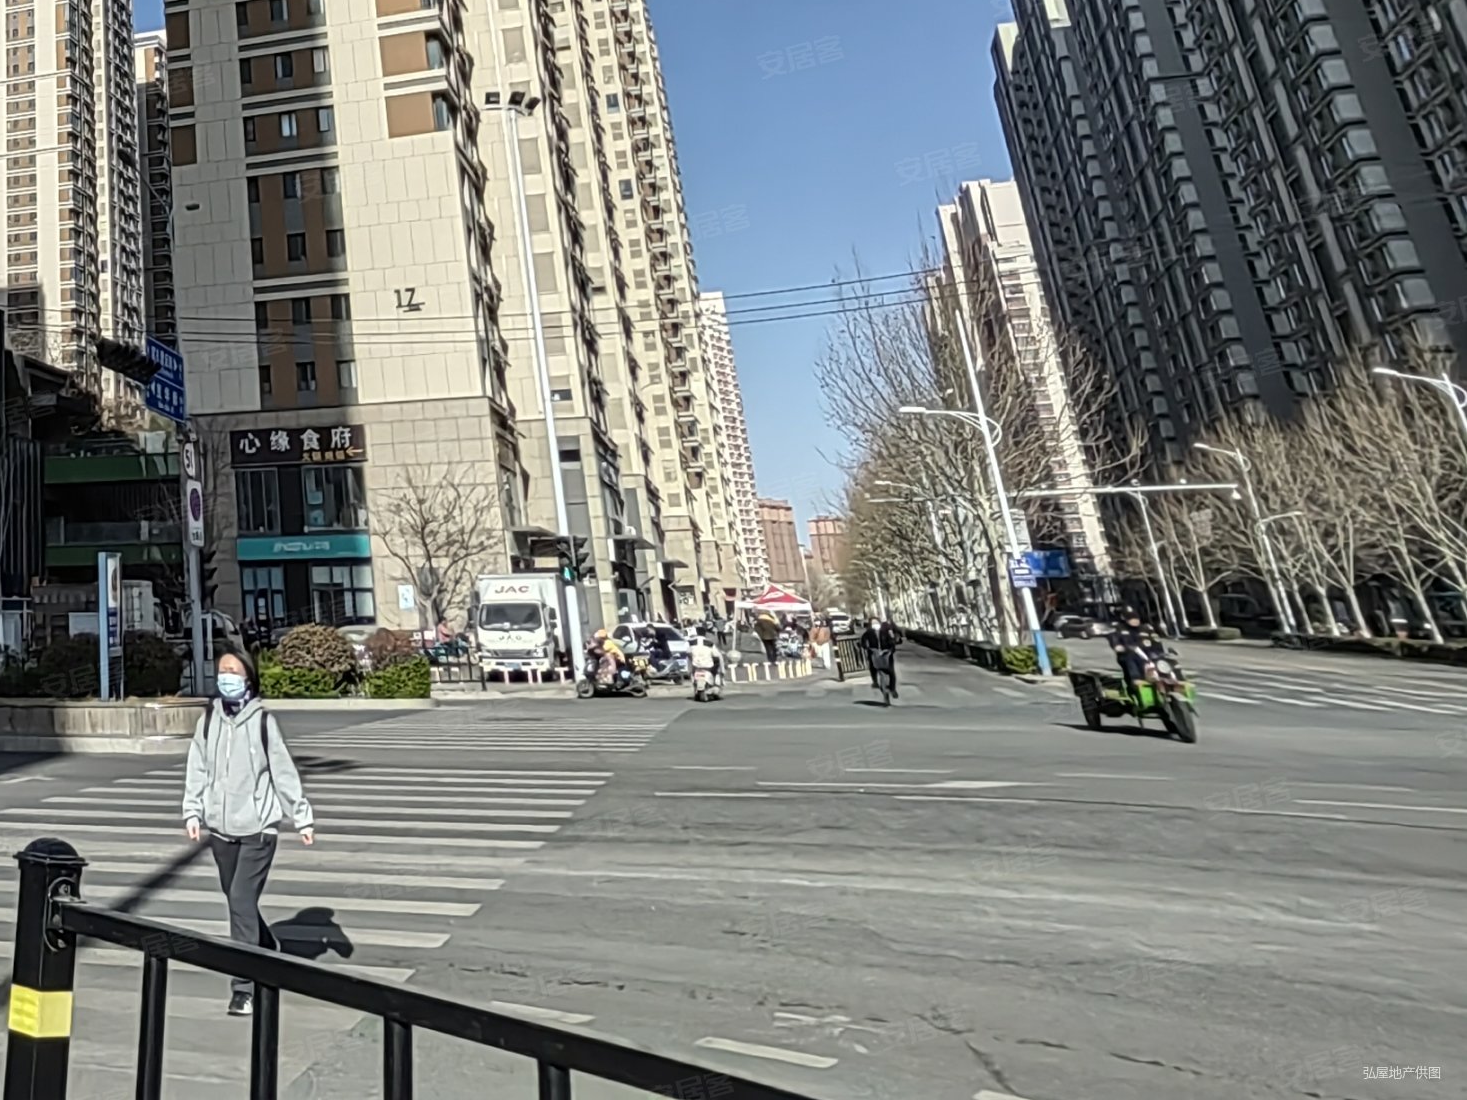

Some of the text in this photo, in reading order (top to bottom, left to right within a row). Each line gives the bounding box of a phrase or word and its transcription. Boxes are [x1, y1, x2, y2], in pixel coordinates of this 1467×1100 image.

[239, 426, 352, 454] 心缘食府
[494, 585, 530, 594] JAC
